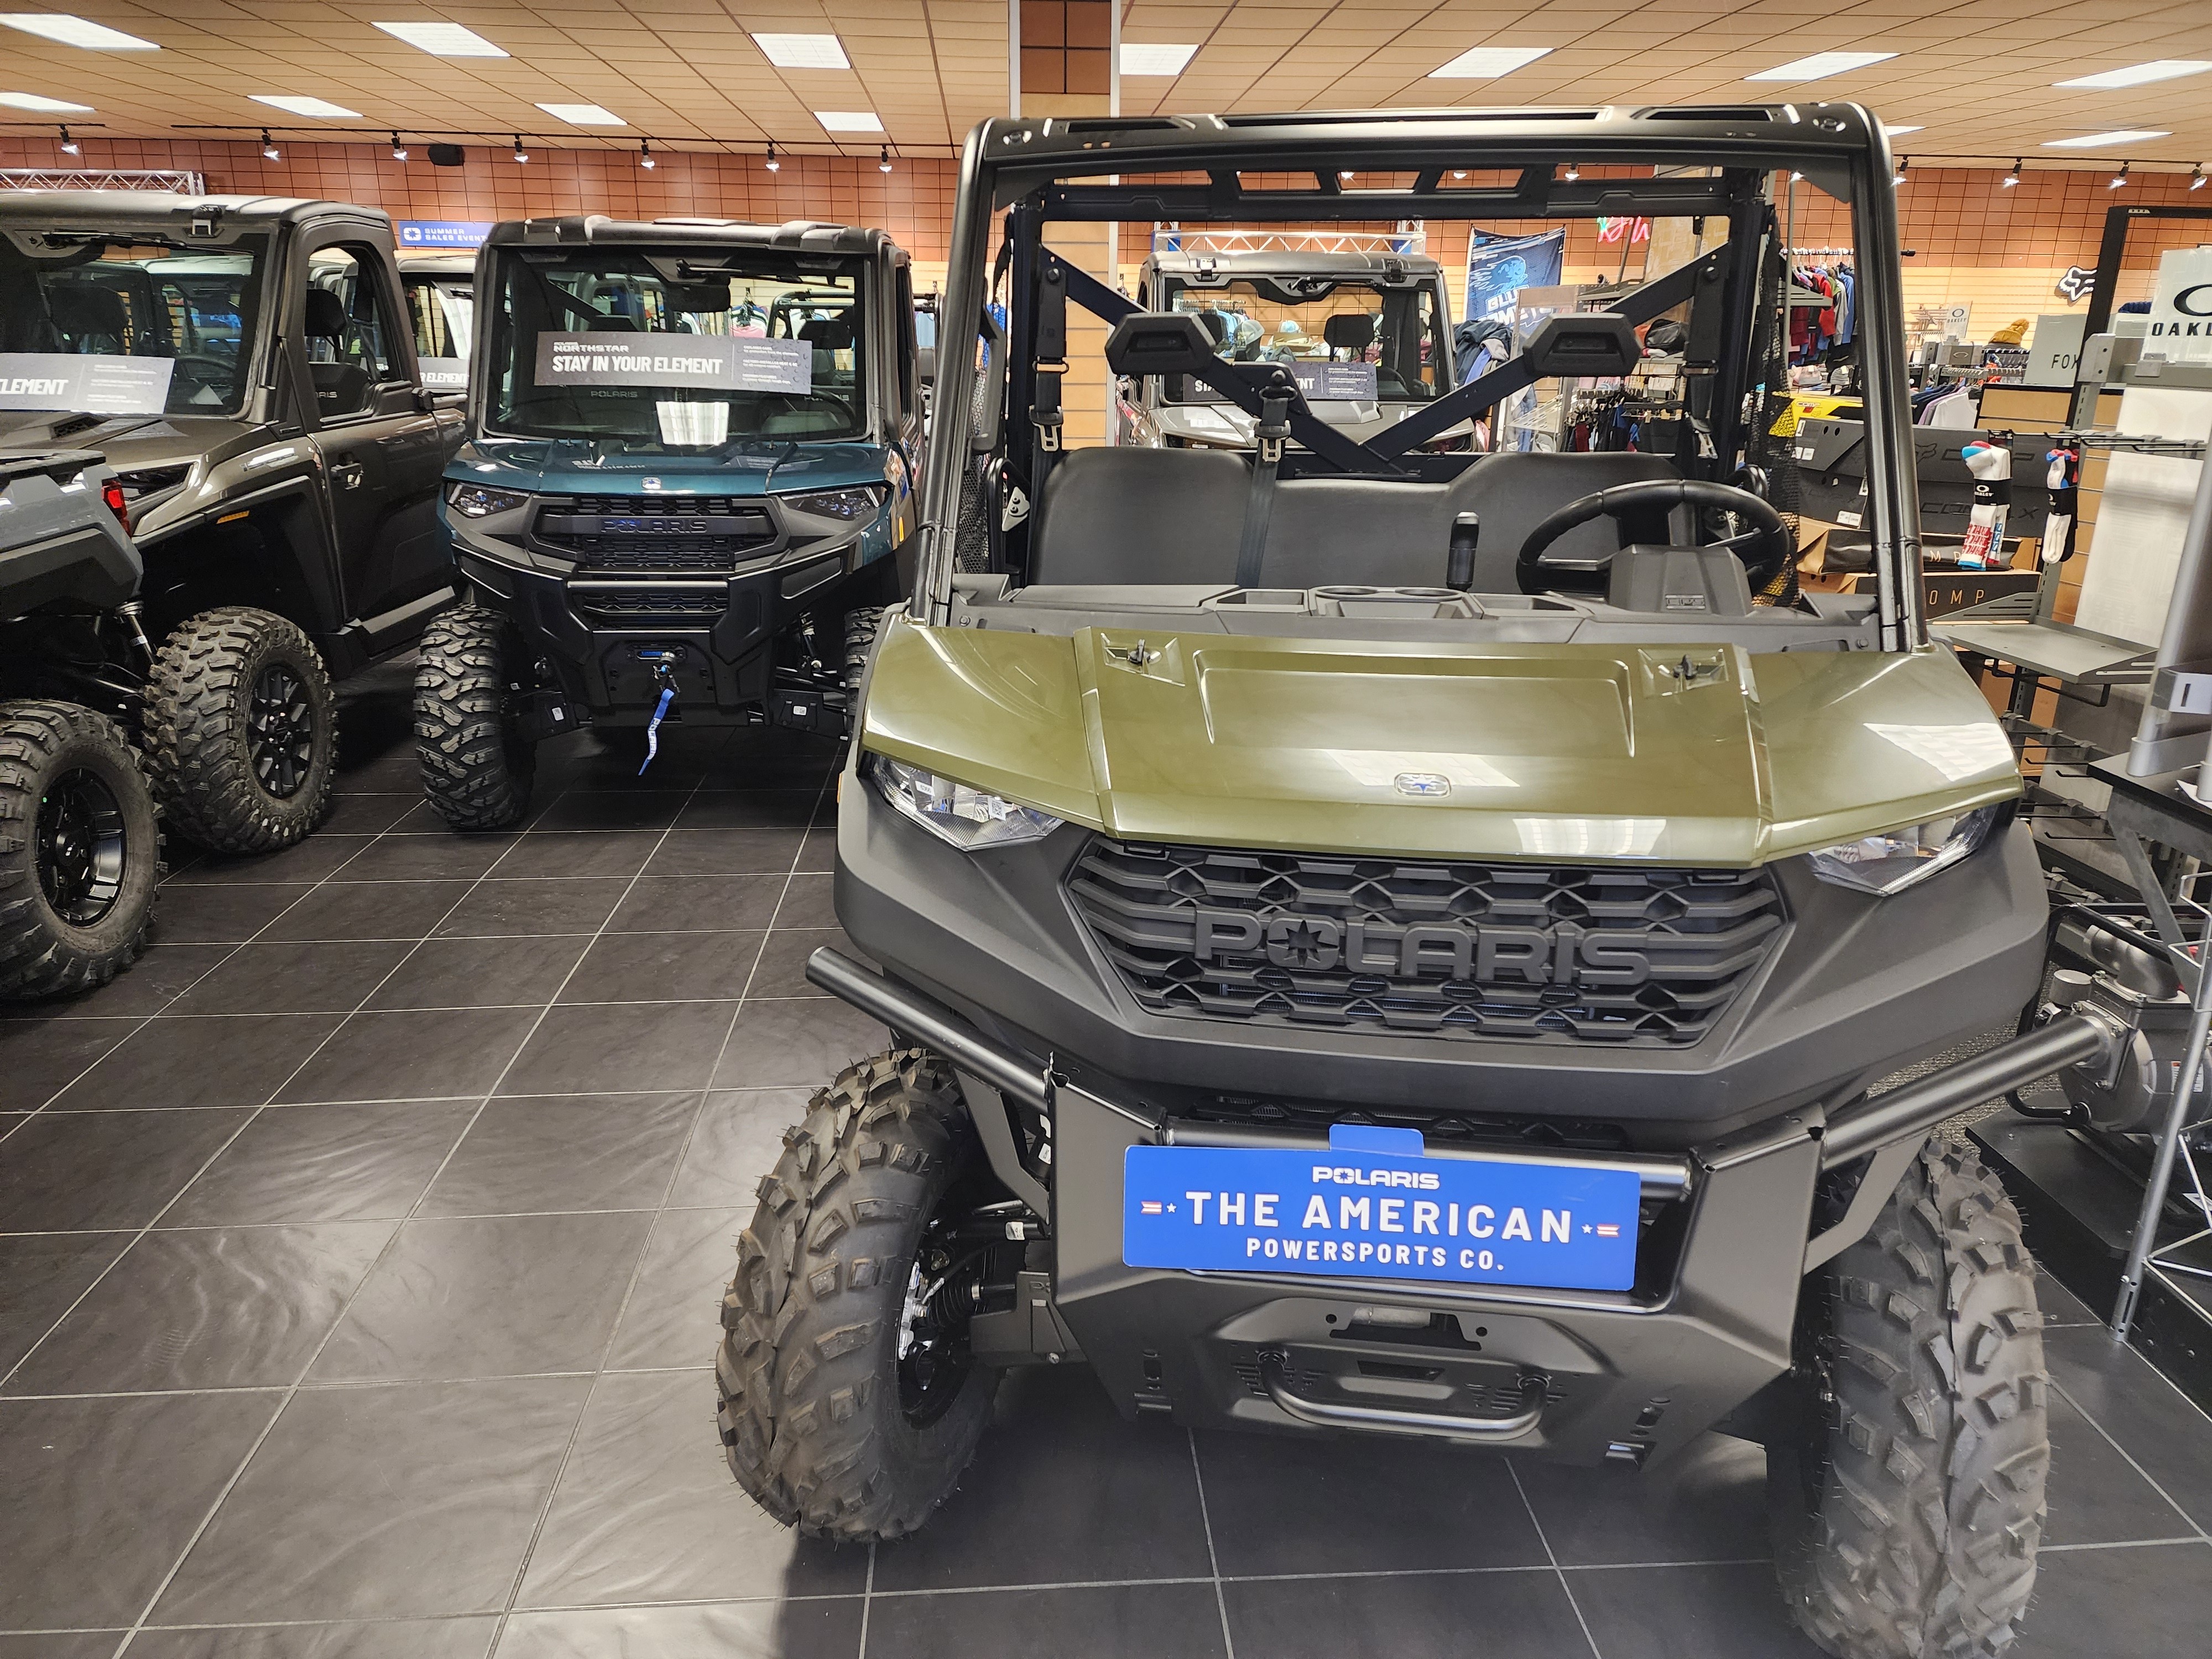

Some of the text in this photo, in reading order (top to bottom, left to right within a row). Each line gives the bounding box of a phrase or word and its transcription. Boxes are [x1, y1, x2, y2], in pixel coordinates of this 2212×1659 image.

[1487, 286, 1520, 312] BLU
[553, 345, 629, 353] NORTHSTAR
[552, 355, 591, 372] STAY
[592, 356, 609, 372] IN
[612, 356, 652, 373] YOUR
[654, 357, 723, 374] ELEMENT
[601, 519, 707, 533] POLARIS
[1929, 589, 1985, 605] OMP
[1193, 907, 1651, 985] POLARIS
[1312, 1166, 1440, 1190] POLARIS
[1186, 1191, 1572, 1244] THE AMERICAN
[1247, 1238, 1504, 1271] POWERSPORTS CO.
